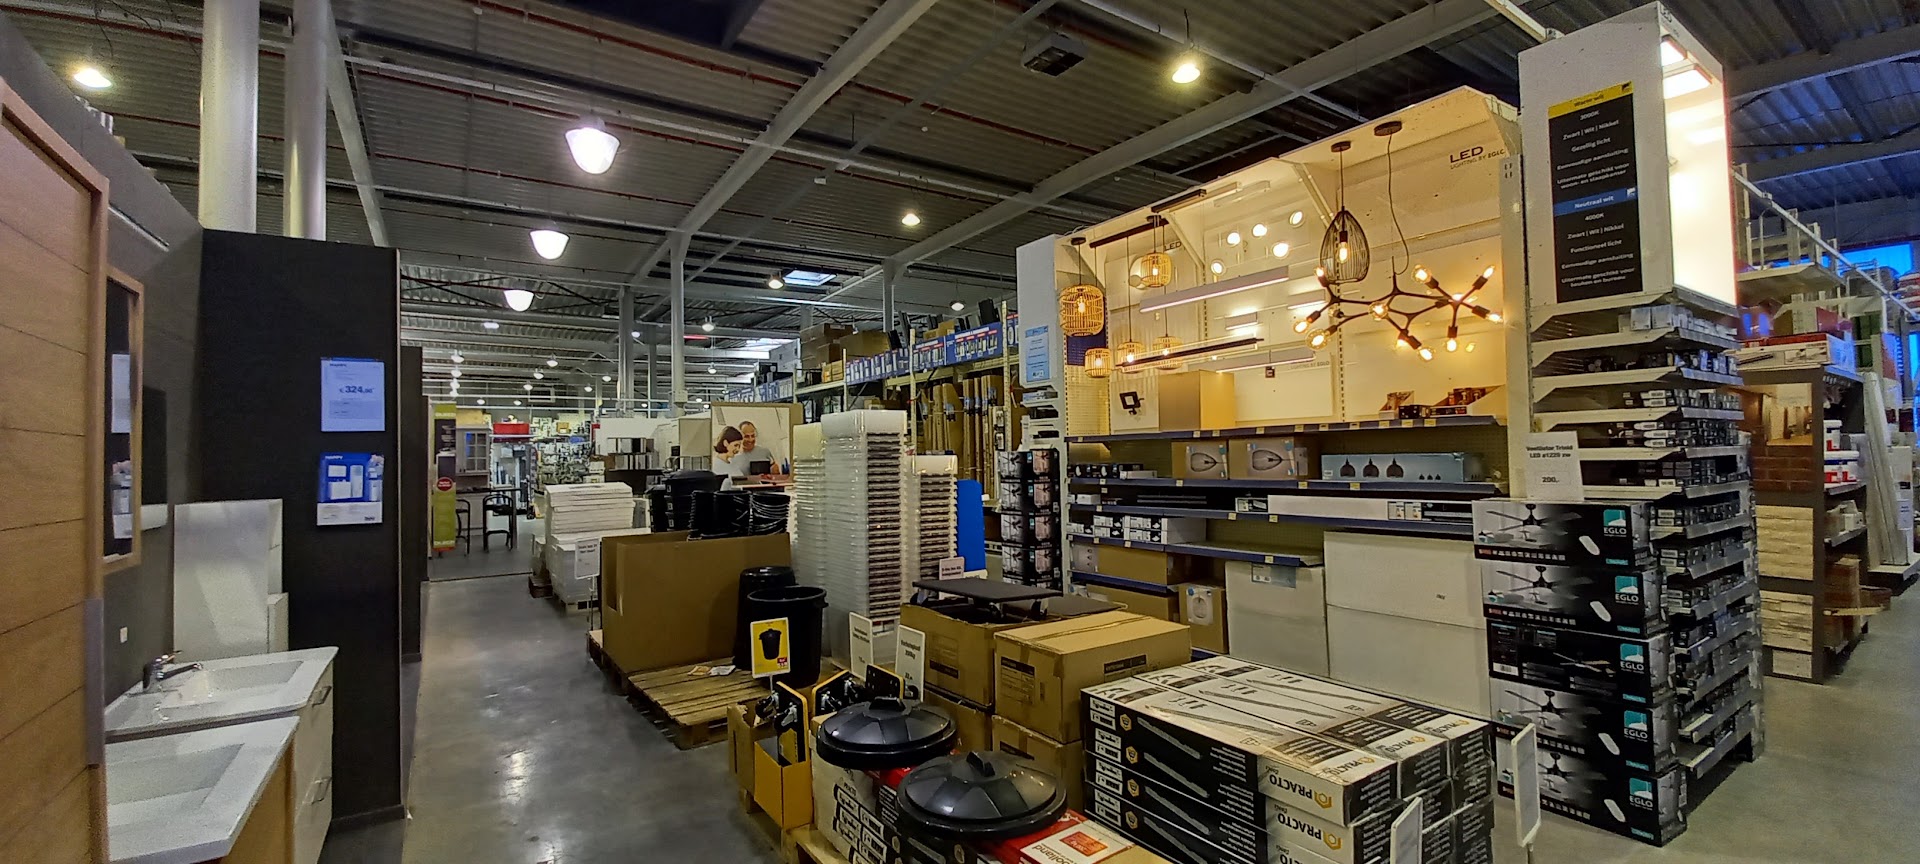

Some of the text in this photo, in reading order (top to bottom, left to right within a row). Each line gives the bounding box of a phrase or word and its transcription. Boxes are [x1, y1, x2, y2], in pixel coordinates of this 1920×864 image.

[1580, 110, 1600, 121] 3000K
[1563, 129, 1581, 140] Zwart
[1599, 120, 1619, 130] Nikkel
[1571, 137, 1611, 153] Gezellig licht
[1450, 146, 1484, 163] LED
[1588, 166, 1614, 178] geschikt
[1614, 162, 1630, 170] voor
[1574, 198, 1602, 209] Neutraal
[1585, 213, 1604, 221] 4000K
[1567, 231, 1585, 240] Zwart
[1604, 223, 1624, 233] Nikkel
[1570, 239, 1622, 253] Functioneel licht
[1604, 526, 1627, 535] EGLO
[1615, 593, 1639, 603] EGLO
[1620, 661, 1645, 671] EGLO
[1624, 728, 1648, 739] EGLO
[1270, 774, 1313, 801] PRACTO
[1630, 795, 1654, 808] EGLO
[1278, 812, 1322, 840] PRACTO
